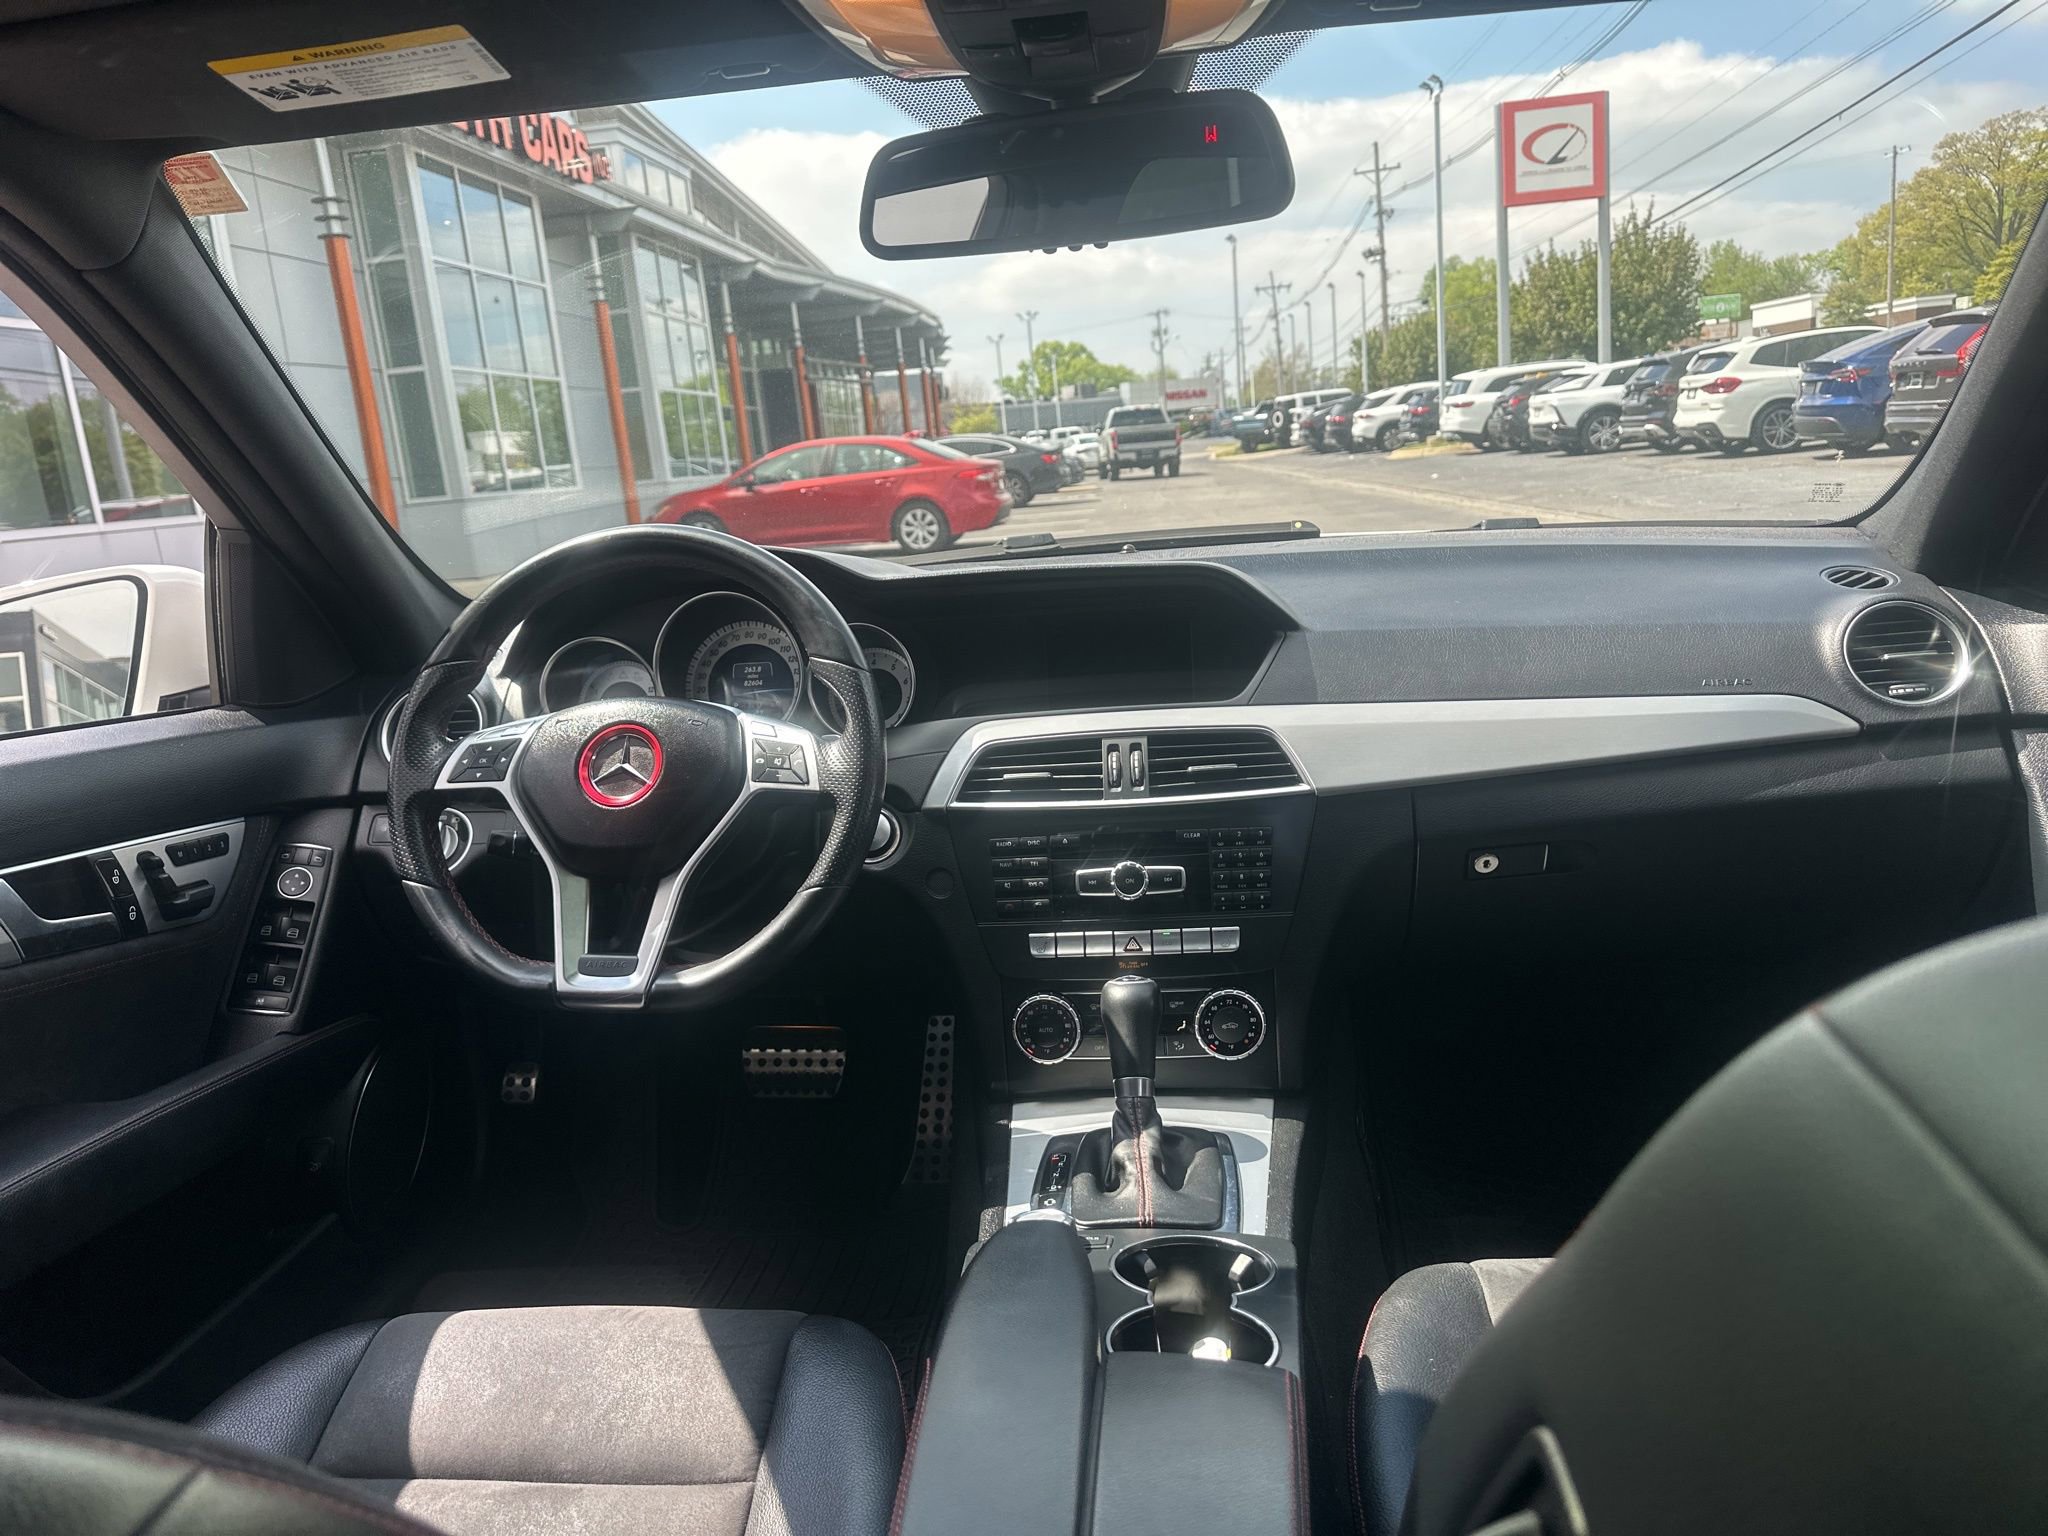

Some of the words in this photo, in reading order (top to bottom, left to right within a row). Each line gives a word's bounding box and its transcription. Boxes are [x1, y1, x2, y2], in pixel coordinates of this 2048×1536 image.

[308, 42, 386, 59] WARNING
[249, 70, 281, 80] EVEN
[285, 65, 318, 76] WITH
[324, 55, 392, 69] ADVANCED
[397, 51, 418, 59] AIR
[424, 45, 457, 55] BAGS
[519, 113, 594, 185] CARS
[1166, 389, 1207, 400] NISSAN
[1702, 678, 1753, 687] AIRBAG
[585, 959, 627, 969] AIRBAG
